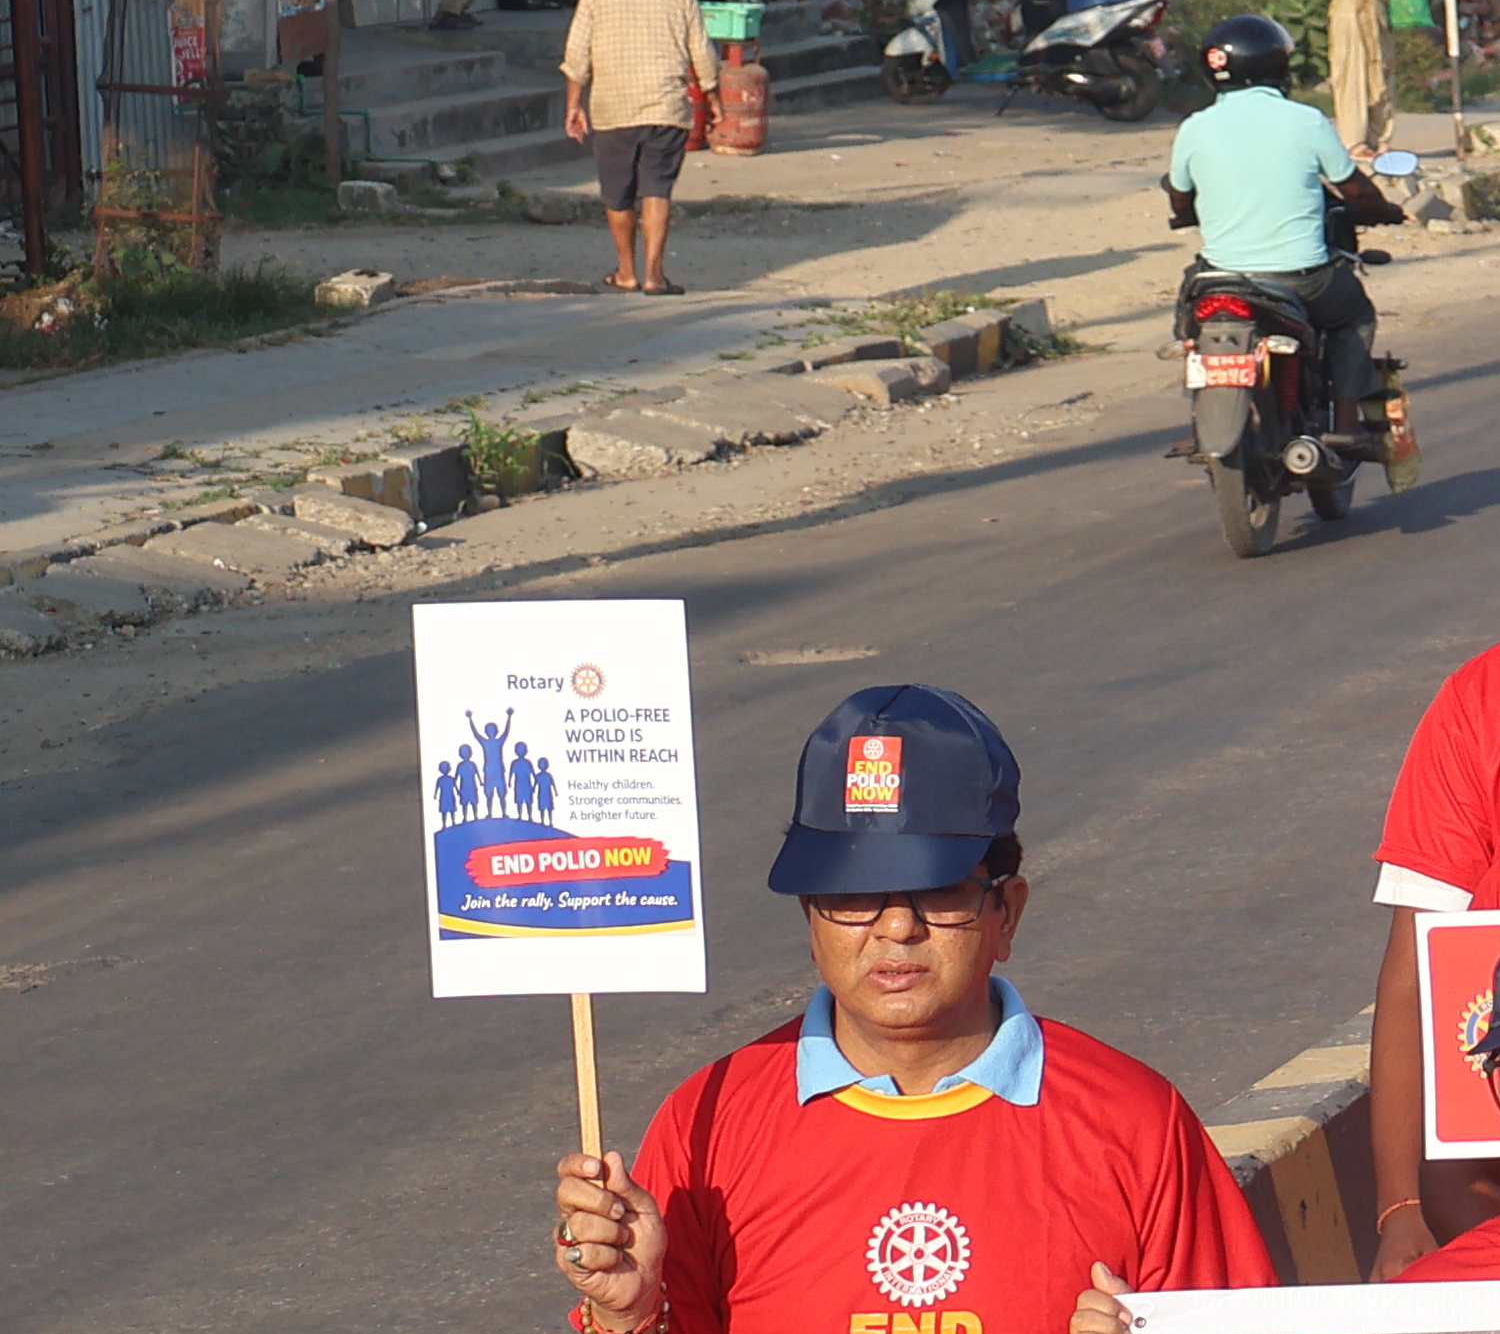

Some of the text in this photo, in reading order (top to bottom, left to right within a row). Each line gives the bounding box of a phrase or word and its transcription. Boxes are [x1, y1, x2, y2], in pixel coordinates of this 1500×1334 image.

[507, 675, 564, 692] Rotary
[564, 709, 670, 722] A POLIO-FREE
[565, 729, 642, 742] WORLD IS
[566, 749, 678, 762] WITHIN REACH
[568, 780, 654, 791] Healthy children.
[568, 795, 682, 806] Stronger communities.
[570, 811, 658, 822] A brighter future.
[491, 847, 651, 876] END POLIO NOW
[461, 891, 677, 911] Join the rally. Support the cause.
